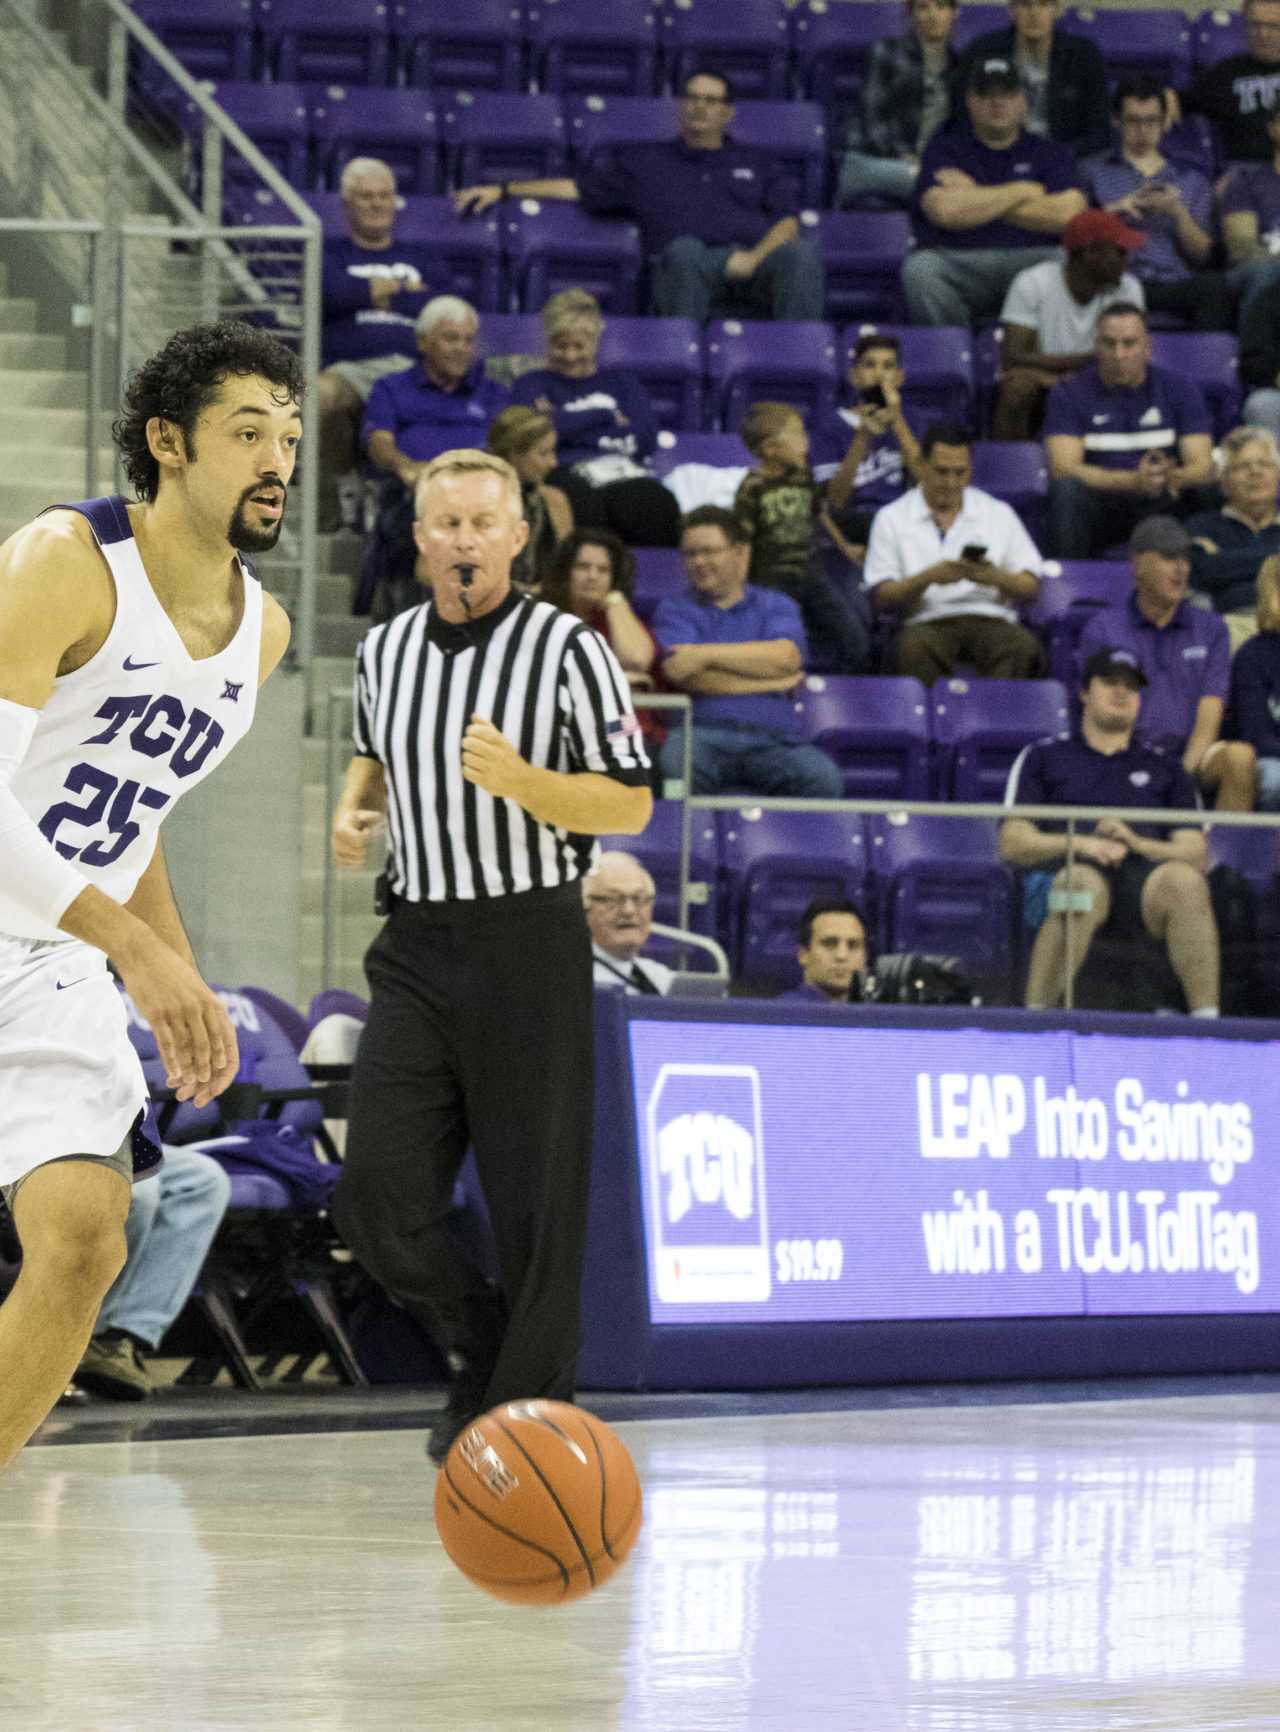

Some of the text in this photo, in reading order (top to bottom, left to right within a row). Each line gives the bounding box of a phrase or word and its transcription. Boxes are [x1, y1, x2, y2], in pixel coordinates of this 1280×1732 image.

[79, 694, 225, 779] TCU
[38, 762, 171, 867] 25
[658, 1111, 753, 1223] TCU
[917, 1073, 1253, 1184] LEAP Into Savings
[775, 1239, 843, 1285] $19.99
[922, 1189, 1005, 1273] with
[1015, 1210, 1042, 1273] a
